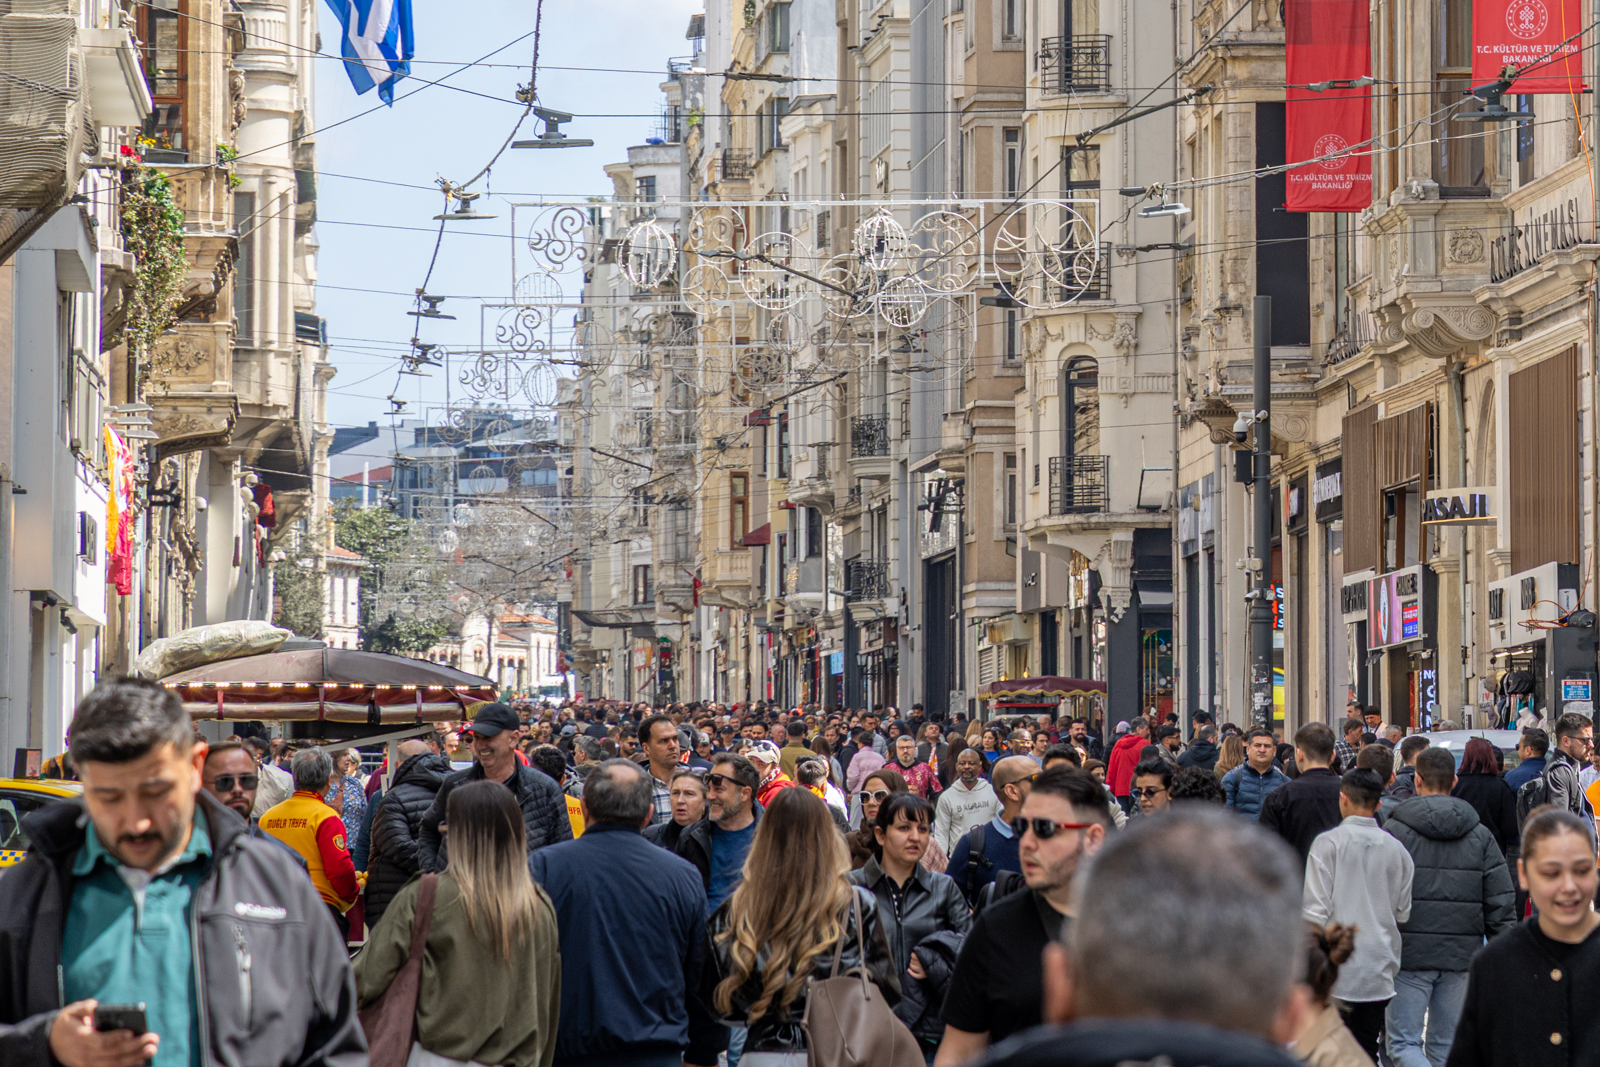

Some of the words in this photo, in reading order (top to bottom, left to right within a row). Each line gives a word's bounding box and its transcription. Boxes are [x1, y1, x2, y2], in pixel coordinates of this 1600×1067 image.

[1476, 45, 1492, 54] T.C.
[1493, 43, 1528, 54] KÜLTÜR
[1530, 44, 1542, 53] VE
[1304, 173, 1333, 181] KÜLTÜR
[1347, 173, 1372, 181] TURİZM
[1421, 494, 1487, 521] PASAJI
[957, 801, 990, 813] BALMAIN
